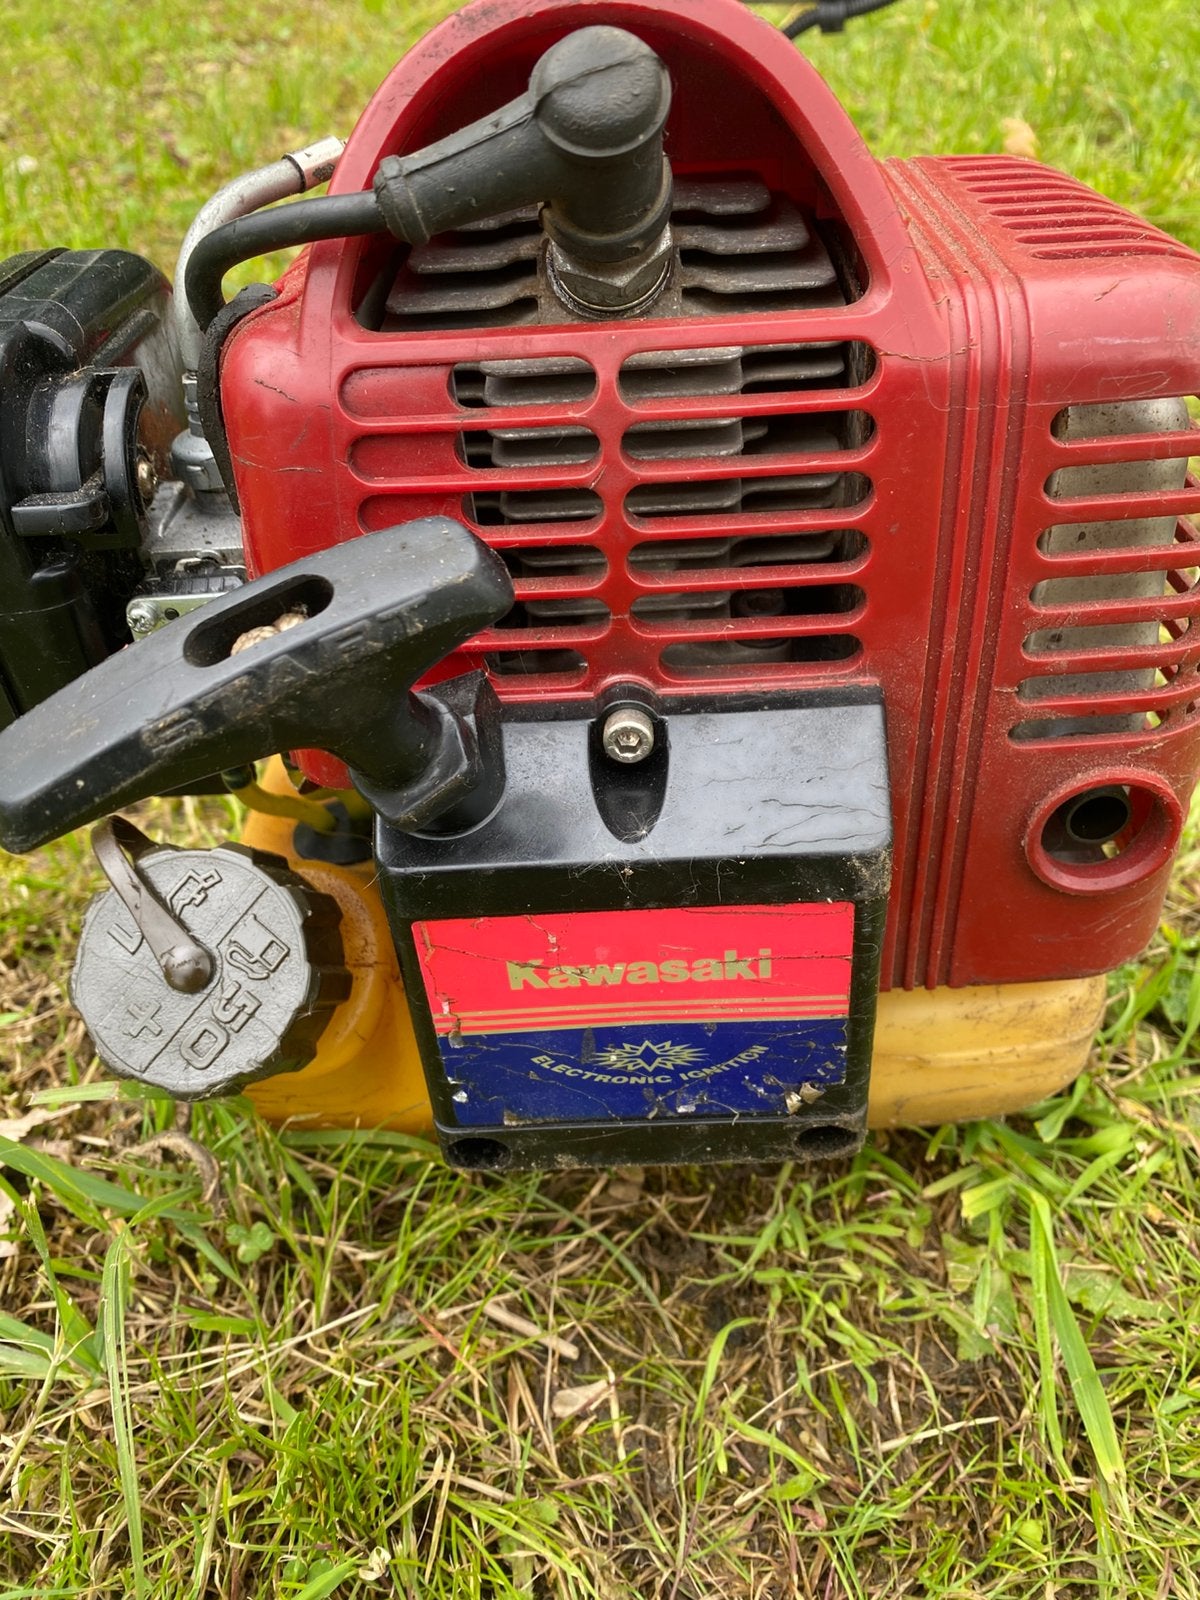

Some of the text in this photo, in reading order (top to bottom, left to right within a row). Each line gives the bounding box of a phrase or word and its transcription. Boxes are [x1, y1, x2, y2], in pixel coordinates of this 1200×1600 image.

[506, 948, 772, 991] Kawasaki
[180, 980, 262, 1070] 50
[530, 1044, 770, 1084] ELECTRONIC IGNITION
